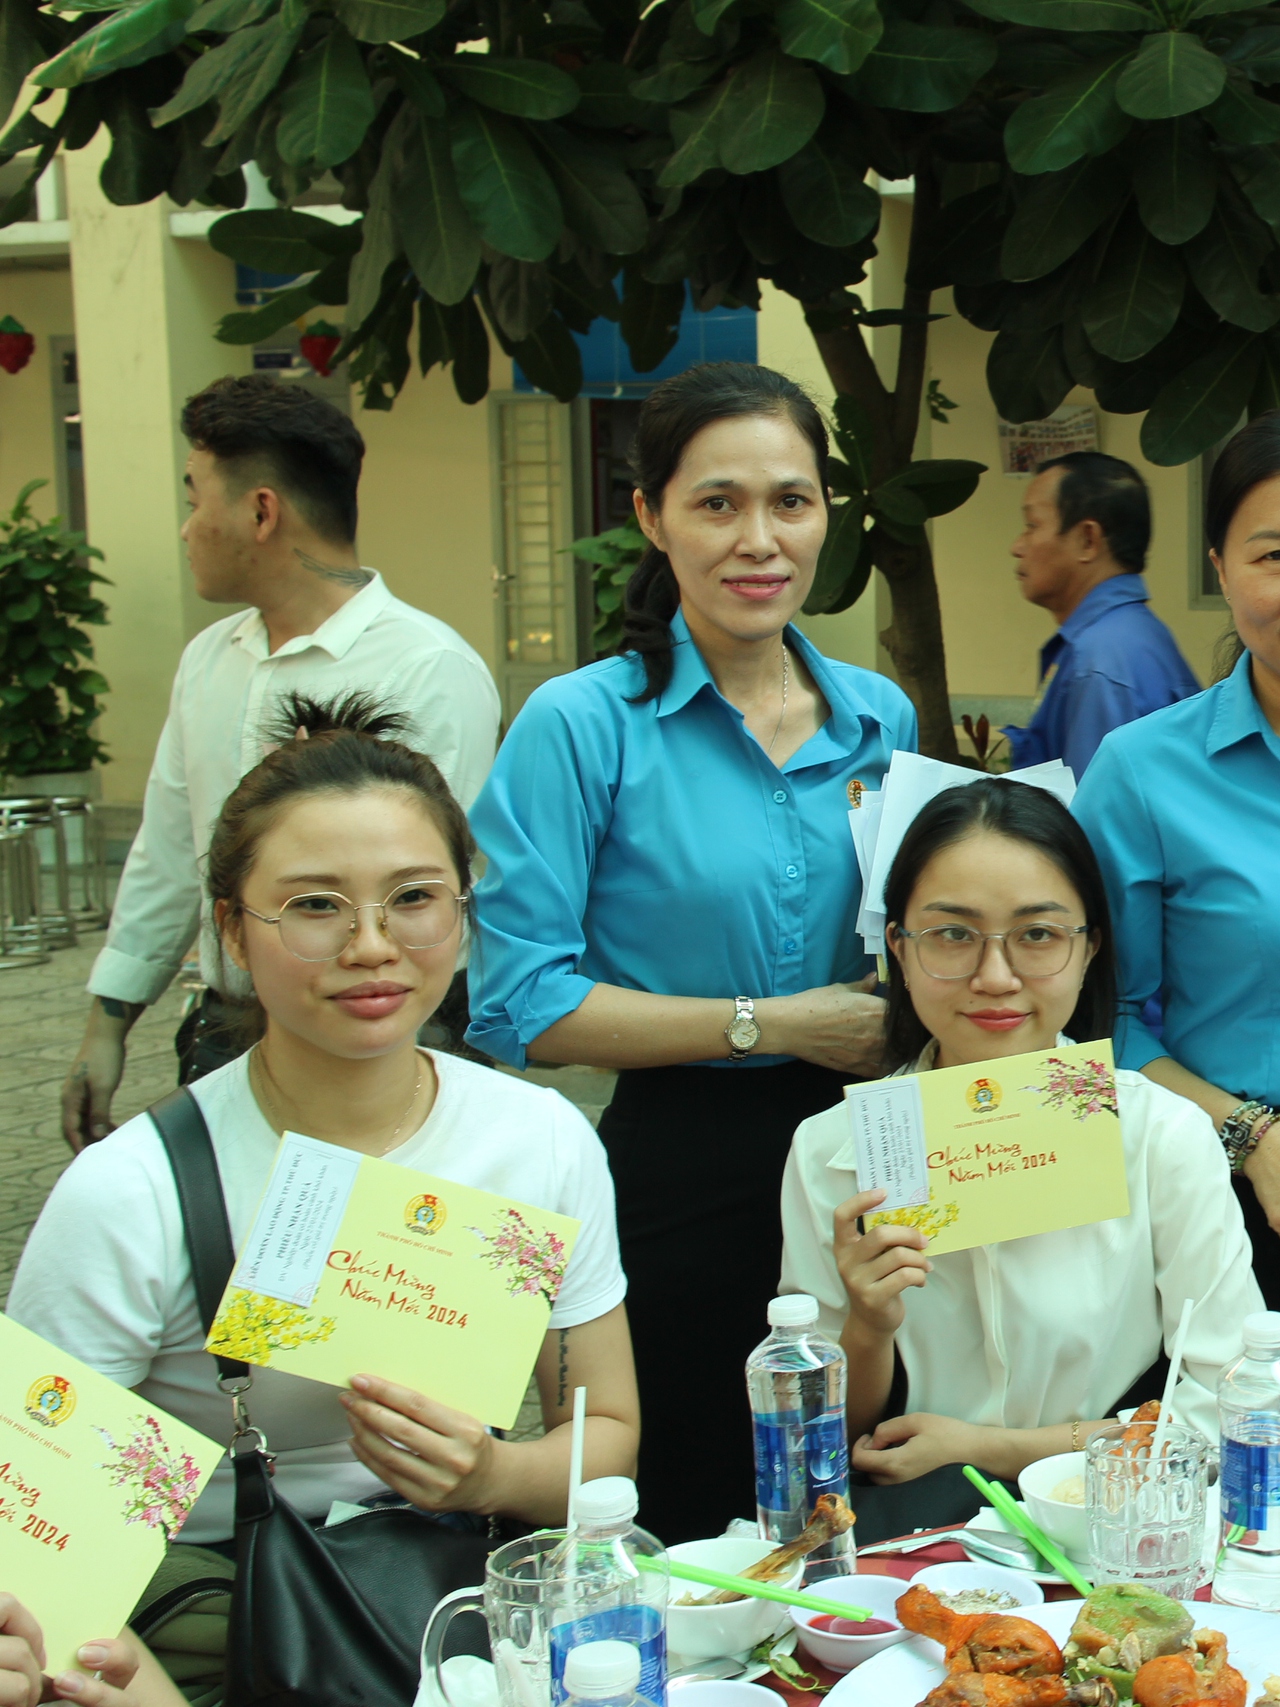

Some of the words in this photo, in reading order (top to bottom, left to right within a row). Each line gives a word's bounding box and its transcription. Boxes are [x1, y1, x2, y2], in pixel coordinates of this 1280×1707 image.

[1022, 1152, 1057, 1170] 2024
[326, 1250, 380, 1278] Chúc
[383, 1263, 436, 1300] Mừng
[340, 1278, 383, 1308] Năm
[386, 1291, 420, 1314] Mới
[427, 1300, 468, 1328] 2024
[20, 1514, 71, 1551] 2024
